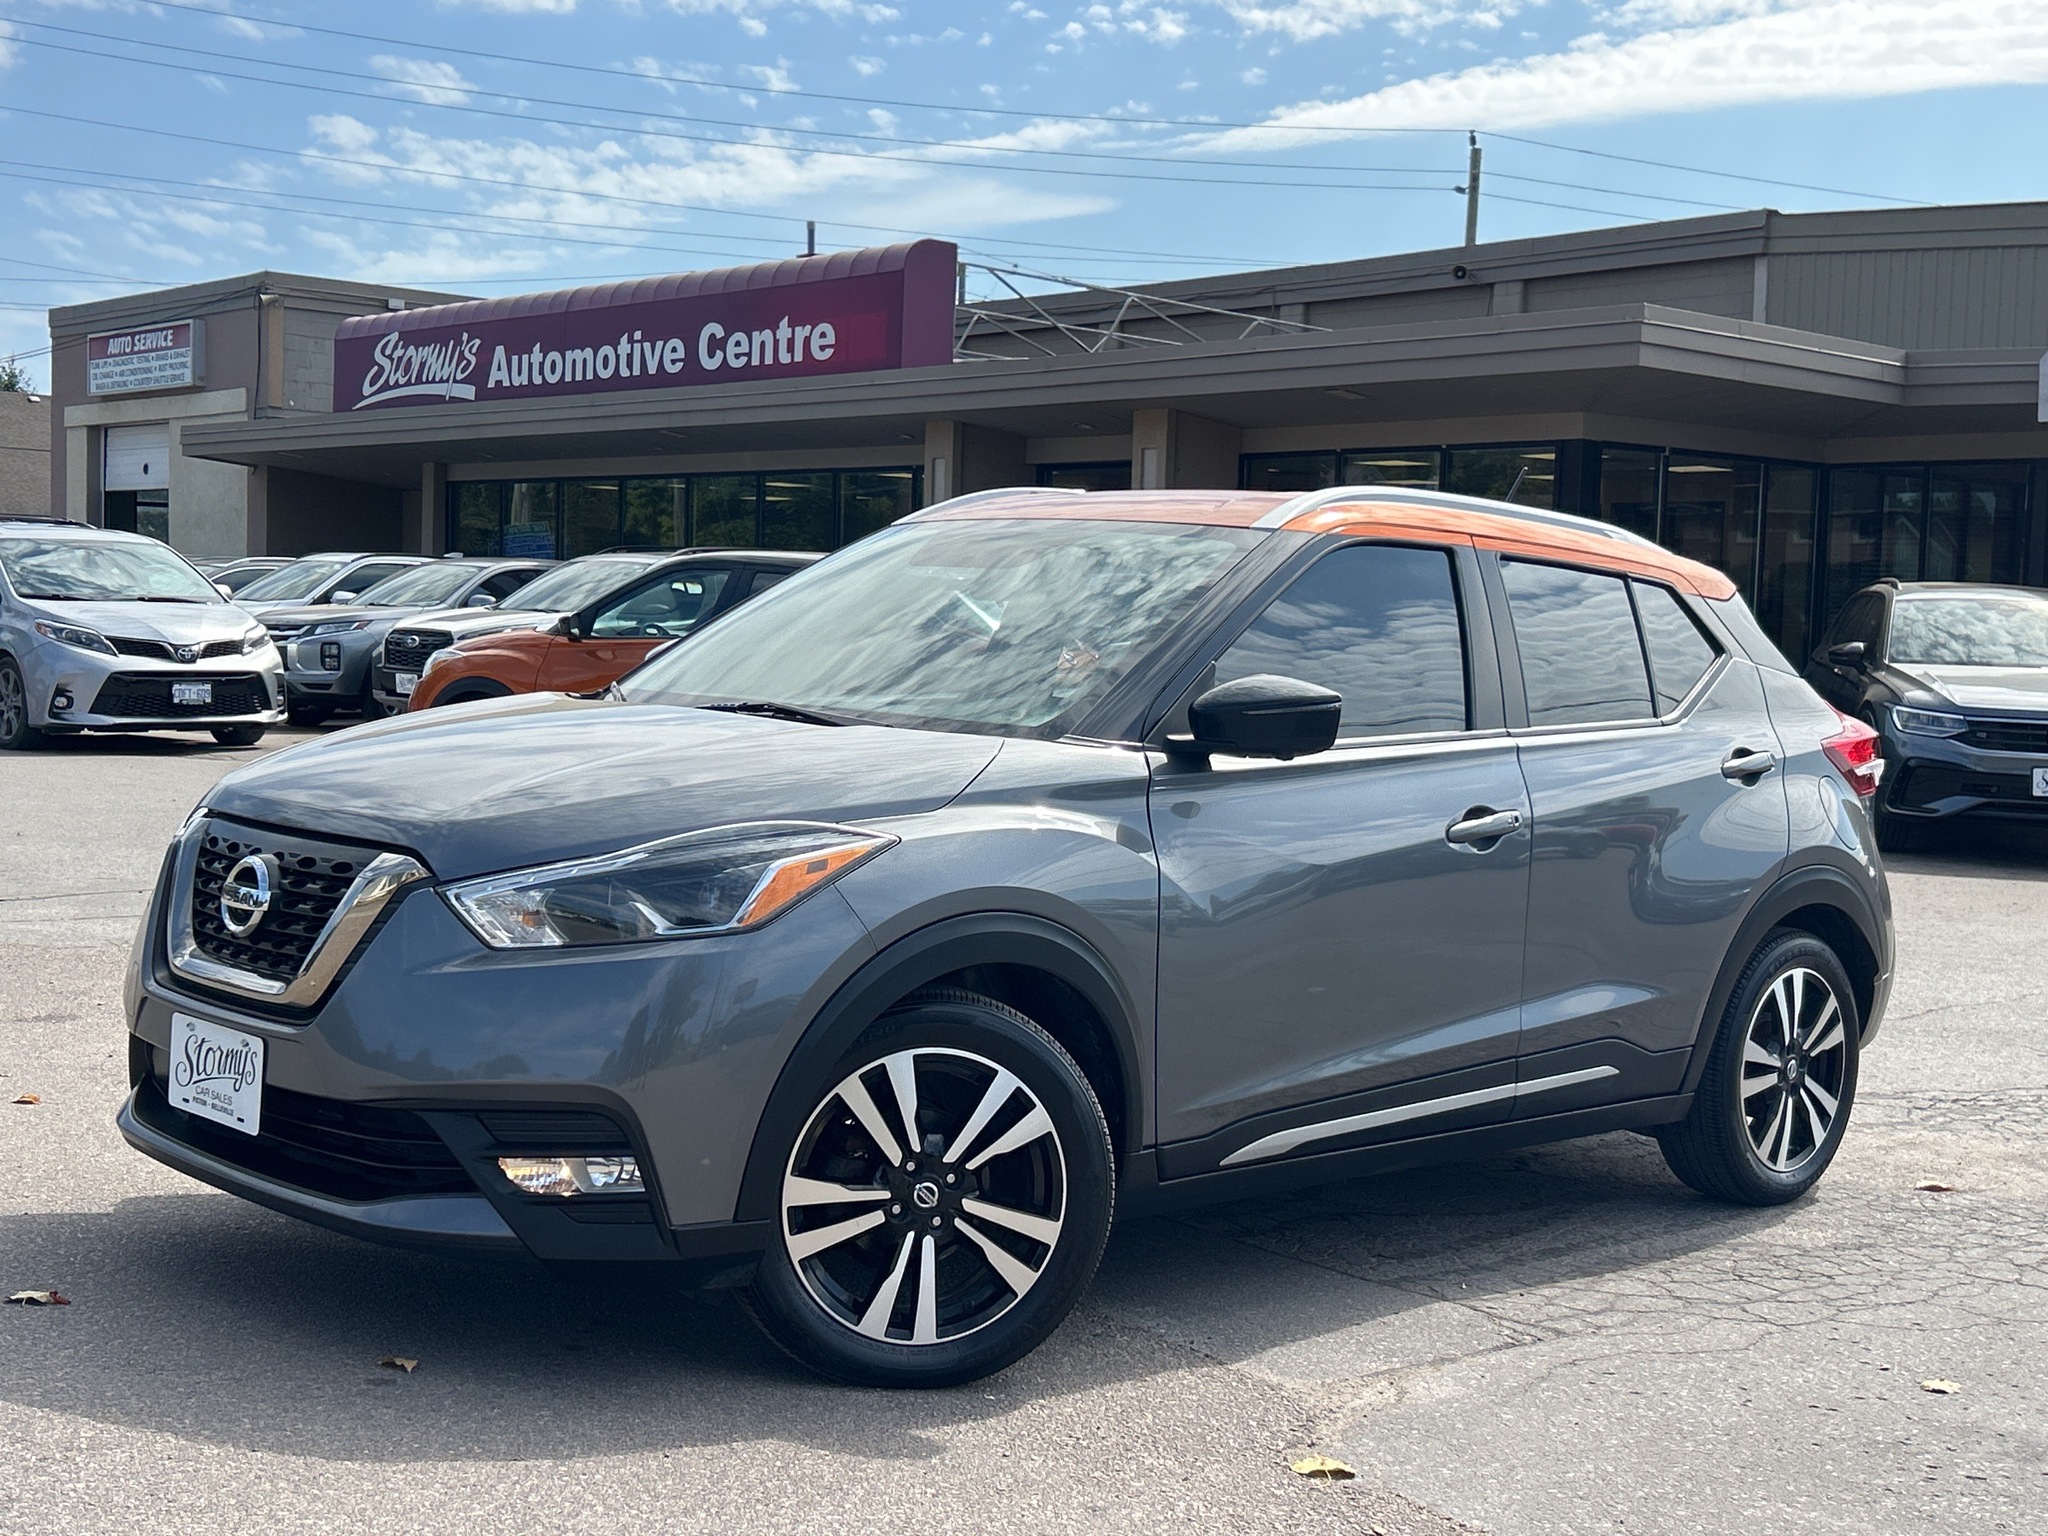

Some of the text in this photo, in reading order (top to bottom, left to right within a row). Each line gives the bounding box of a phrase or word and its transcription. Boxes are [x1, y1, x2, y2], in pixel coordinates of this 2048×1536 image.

[108, 330, 173, 355] AUTO SERVICE
[362, 315, 836, 400] Stormy's Automotive Centre
[175, 1033, 257, 1092] Stormy's
[195, 1085, 233, 1106] CAR SALES
